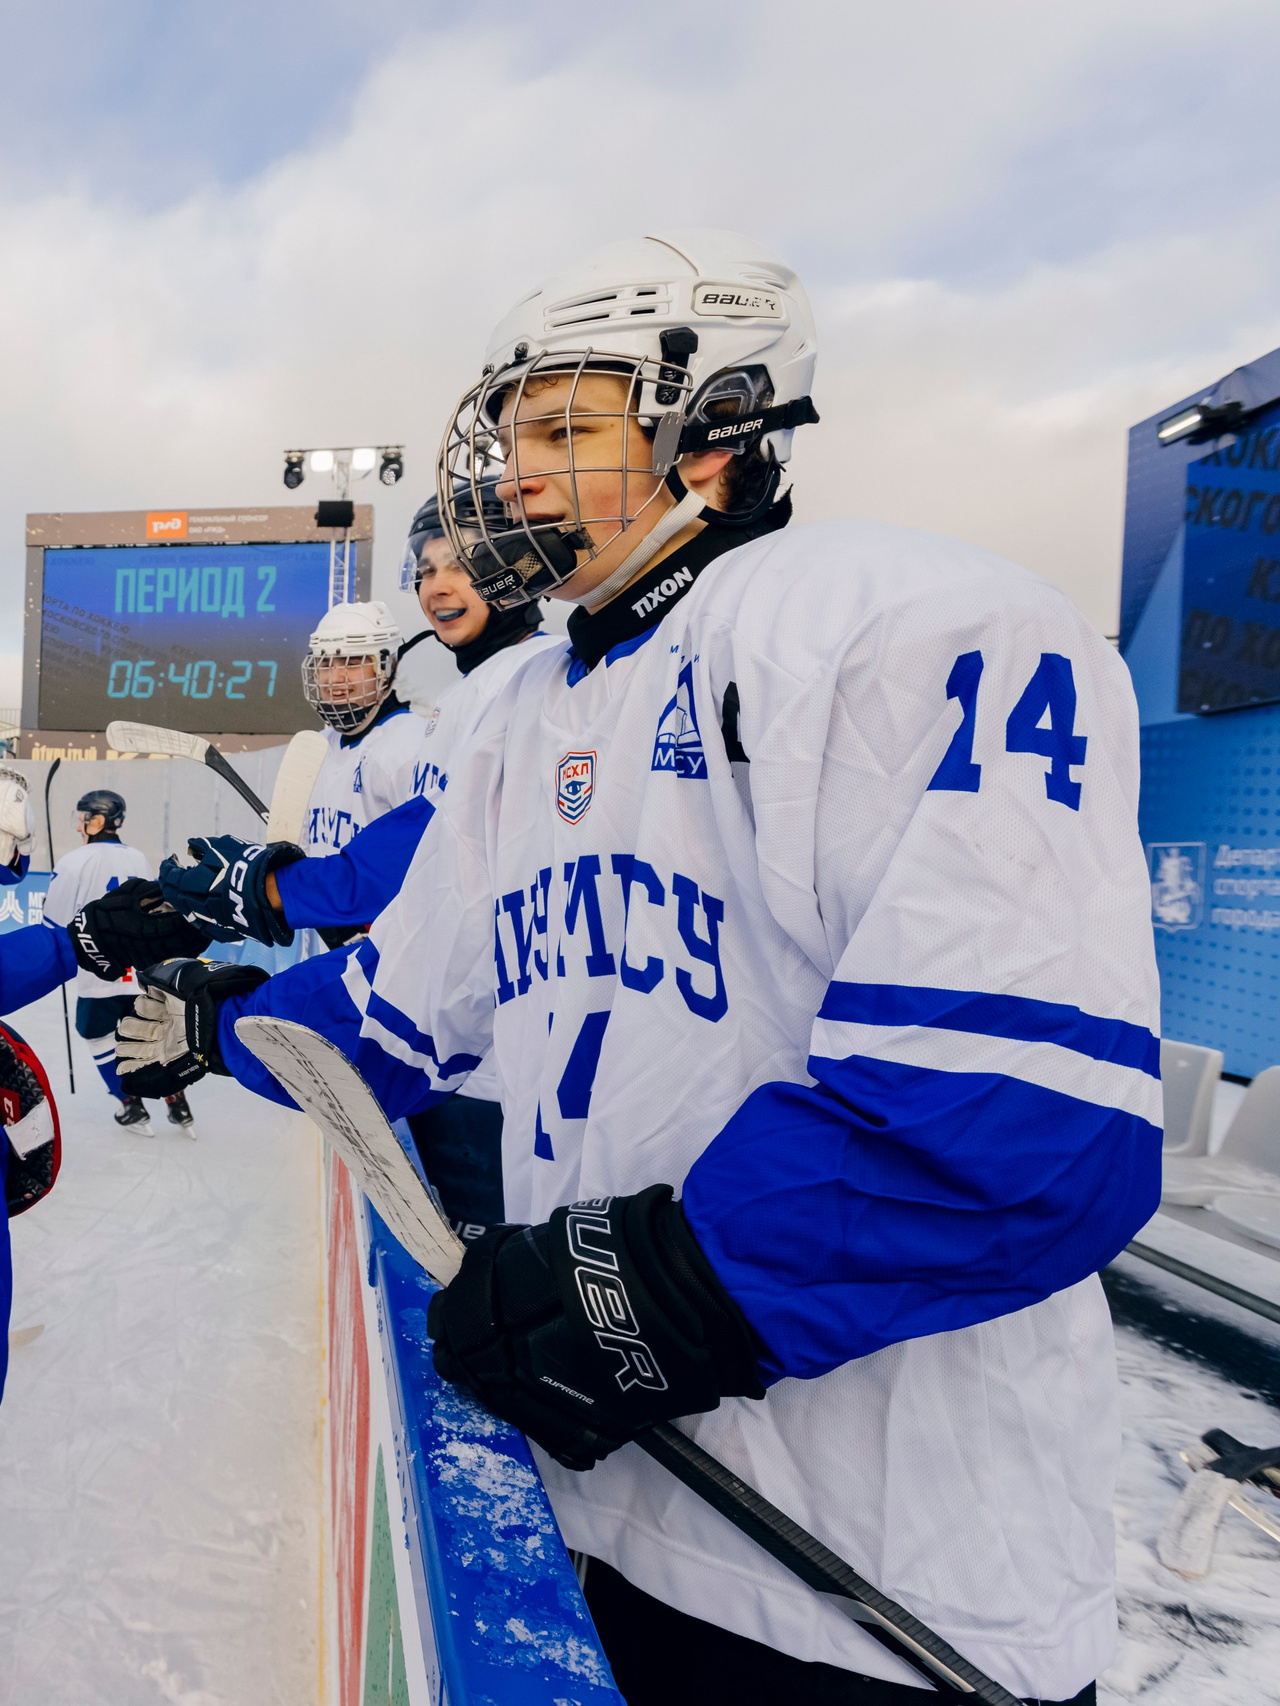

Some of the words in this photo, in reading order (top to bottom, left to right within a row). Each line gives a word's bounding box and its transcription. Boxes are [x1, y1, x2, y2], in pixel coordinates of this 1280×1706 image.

[702, 293, 775, 311] BAU
[708, 418, 763, 440] BAUER
[115, 566, 245, 618] ПЕРИОД
[257, 566, 277, 611] 2
[631, 566, 694, 618] TIXON
[107, 660, 277, 699] 06:40:27
[925, 650, 1088, 811] 14
[228, 843, 266, 928] CCM
[566, 1195, 669, 1392] AUER
[539, 1375, 595, 1405] SUPREME
